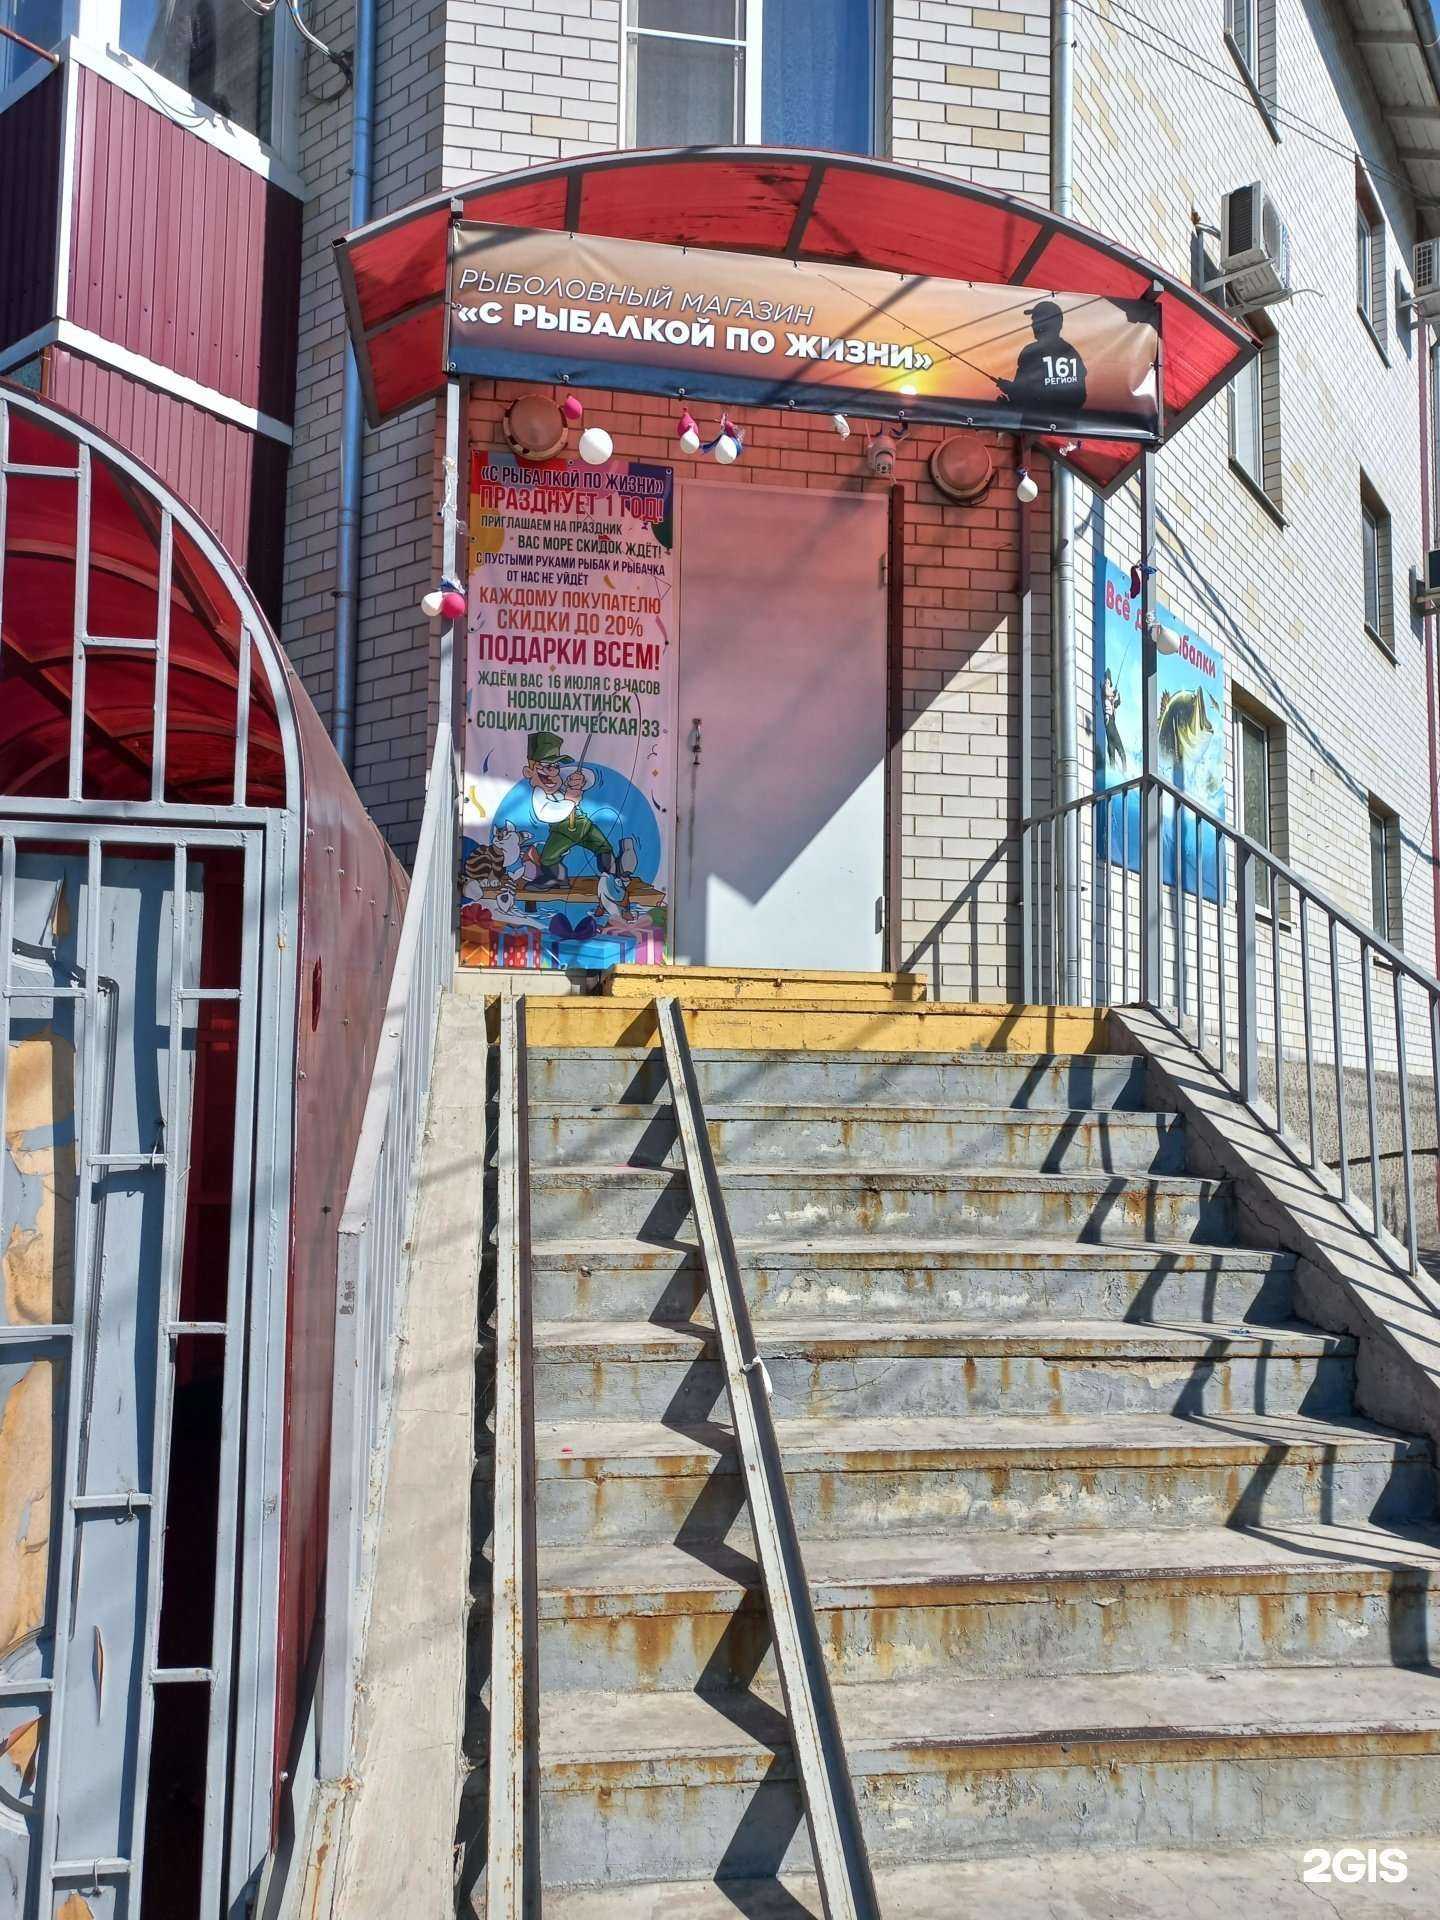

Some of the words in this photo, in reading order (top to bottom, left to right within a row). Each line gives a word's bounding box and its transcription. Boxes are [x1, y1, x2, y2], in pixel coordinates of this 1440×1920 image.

[459, 269, 673, 310] РЫБОЛОВНЫЙ
[681, 293, 815, 326] МАГАЗИН
[458, 302, 504, 324] «С
[512, 303, 716, 349] РЫБАЛКОЙ
[726, 326, 775, 354] ПО
[785, 333, 933, 370] ЖИЗНИ»
[1042, 356, 1077, 378] 161
[1045, 376, 1078, 385] РЕГИОН
[481, 466, 498, 481] «С
[502, 467, 580, 487] РЫБАЛКОЙ
[584, 472, 601, 488] ПО
[606, 473, 664, 493] ЖИЗНИ»
[480, 486, 597, 515] ПРАЗДНУЕТ
[606, 496, 612, 516] 1
[620, 498, 664, 523] ГОД!
[481, 515, 551, 530] ПРИГЛАШАЕМ
[554, 522, 567, 532] НА
[570, 523, 622, 535] ПРАЗДНИК
[518, 535, 540, 549] ВАС
[543, 538, 573, 551] МОРЕ
[577, 539, 622, 555] СКИДОК
[626, 543, 662, 559] ЖДЁТ!
[476, 552, 483, 563] С
[485, 553, 533, 566] ПУСТЫМИ
[536, 556, 575, 569] РУКАМИ
[578, 560, 610, 570] РЫБАК
[613, 561, 619, 571] И
[622, 562, 665, 576] РЫБАЧКА
[507, 570, 520, 581] ОТ
[521, 571, 539, 583] НАС
[542, 573, 554, 583] НЕ
[556, 572, 588, 586] УЙДЁТ
[480, 587, 558, 607] КАЖДОМУ
[563, 592, 661, 614] ПОКУПАТЕЛЮ
[1105, 580, 1130, 620] Всё
[497, 609, 569, 634] СКИДКИ
[575, 613, 600, 635] ДО
[605, 615, 643, 637] 20%
[479, 634, 586, 665] ПОДАРКИ
[594, 642, 660, 670] ВСЕМ!
[478, 671, 517, 687] ЖДЁМ
[520, 674, 543, 688] ВАС
[549, 675, 561, 689] 16
[565, 676, 600, 690] ИЮЛЯ
[604, 679, 610, 691] С
[625, 679, 660, 695] ЧАСОВ
[507, 691, 631, 713] НОВОШАХТИНСК
[477, 711, 638, 736] СОЦИАЛИСТИЧЕСКАЯ
[642, 720, 660, 737] 33
